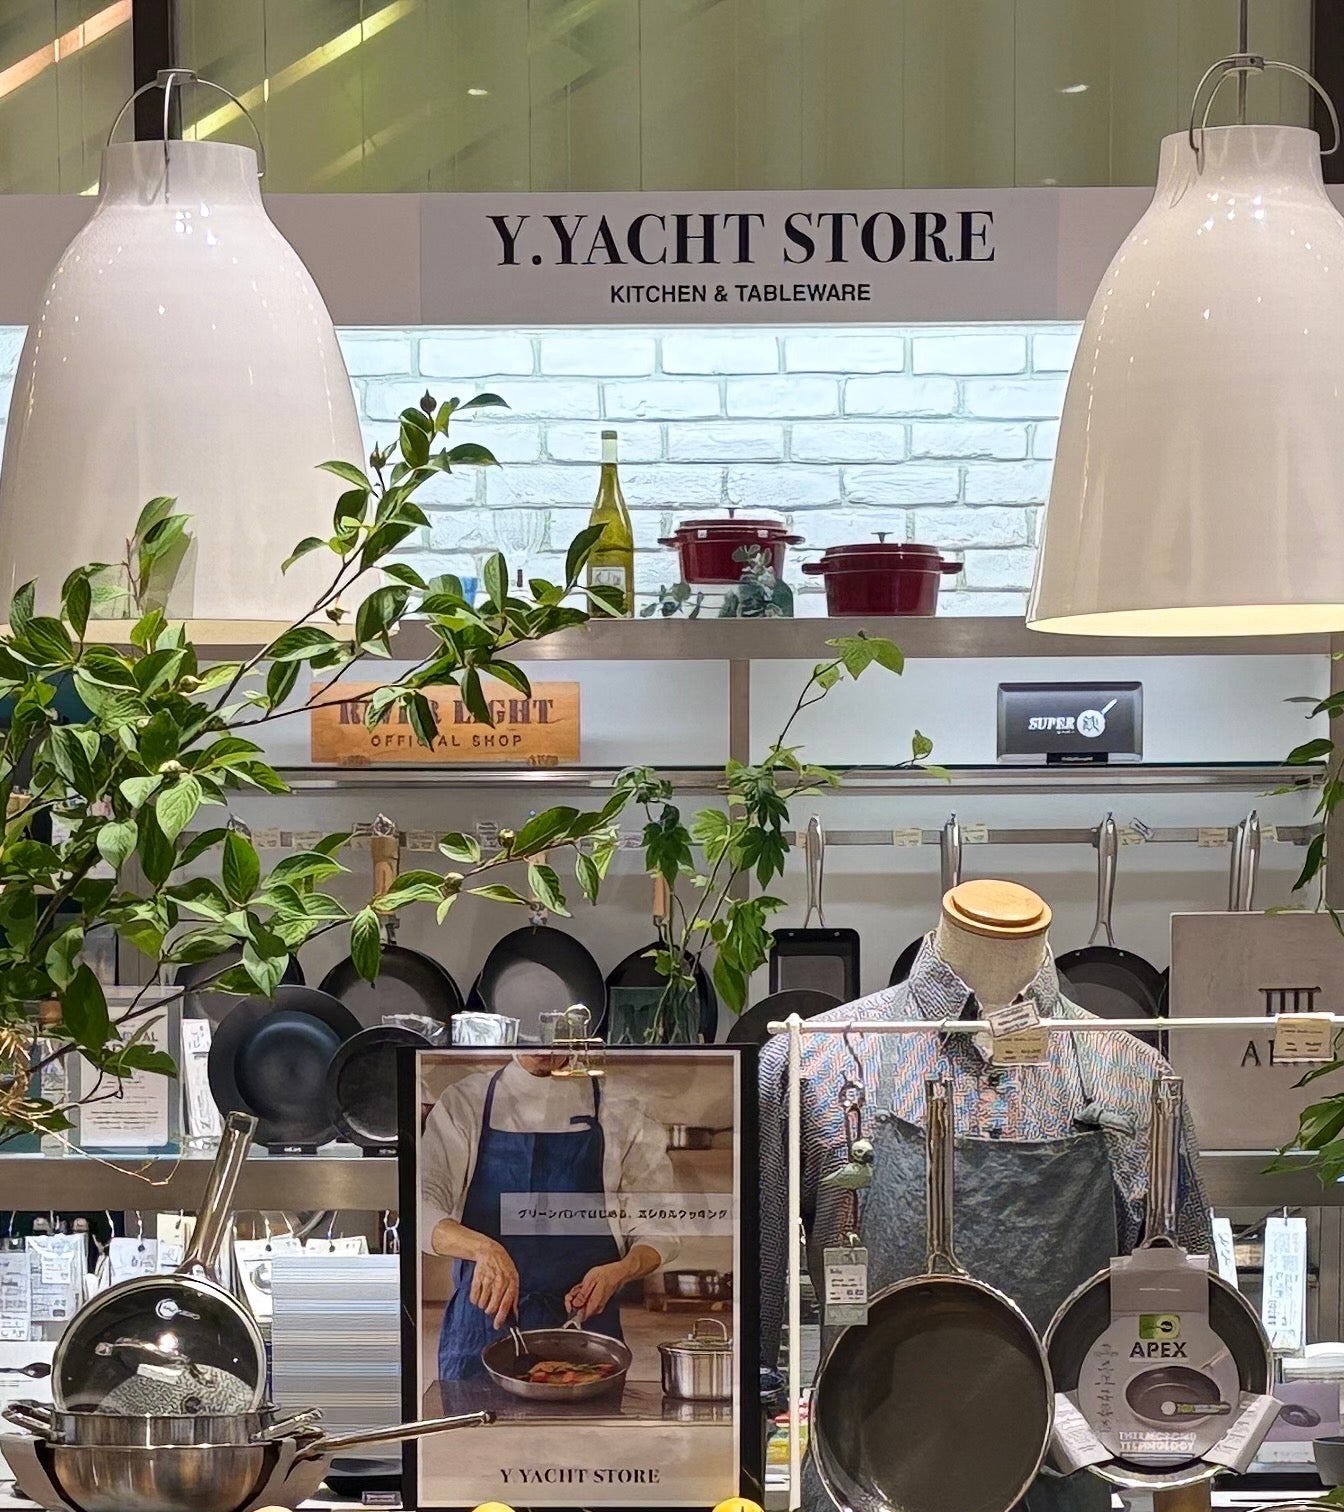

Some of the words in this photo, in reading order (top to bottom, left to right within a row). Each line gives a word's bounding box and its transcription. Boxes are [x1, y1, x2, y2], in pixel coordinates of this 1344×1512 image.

[486, 212, 764, 267] Y.YACHT
[783, 209, 996, 265] STORE
[610, 284, 706, 304] KITCHEN
[713, 284, 729, 303] &
[735, 283, 871, 303] TABLEWARE
[453, 699, 554, 725] LGHT
[371, 735, 460, 747] OFFICAL
[472, 735, 522, 747] SHOP
[1130, 1341, 1188, 1359] APEX
[593, 1468, 660, 1484] STORE
